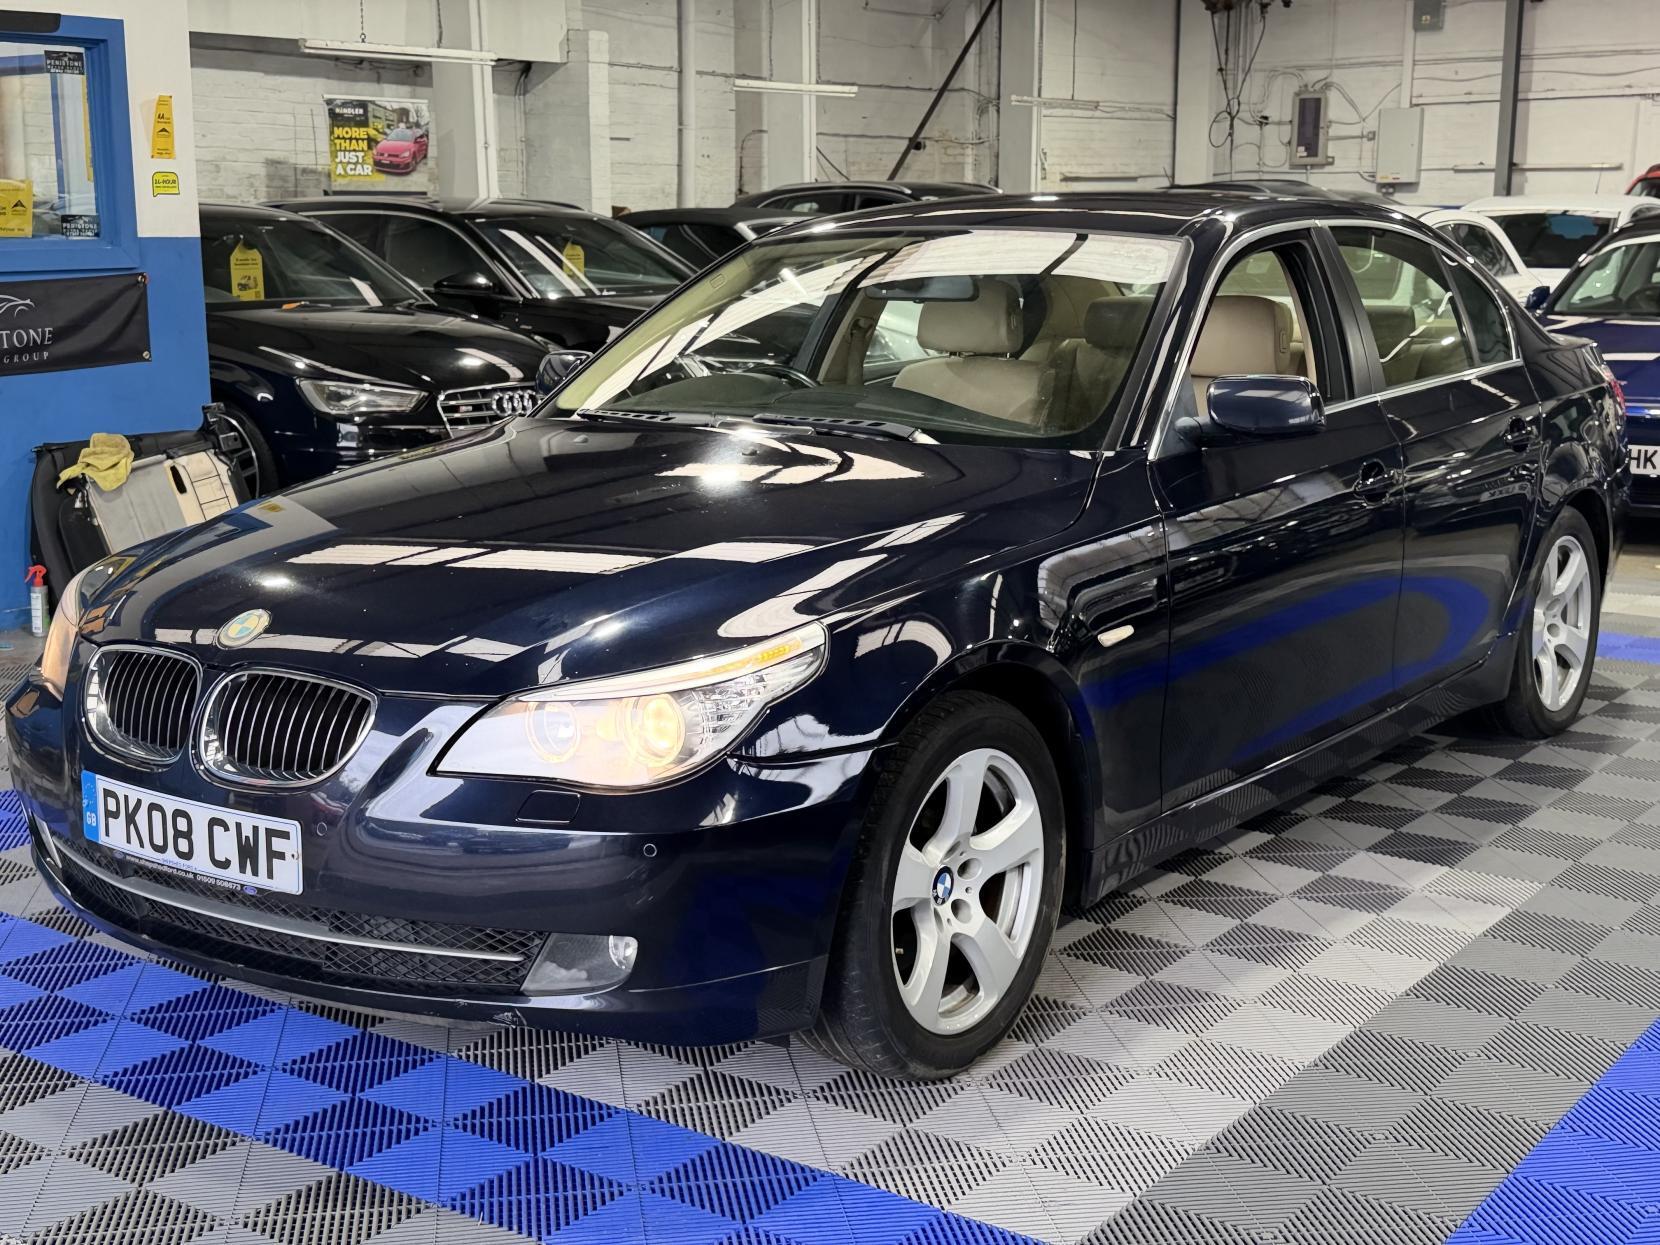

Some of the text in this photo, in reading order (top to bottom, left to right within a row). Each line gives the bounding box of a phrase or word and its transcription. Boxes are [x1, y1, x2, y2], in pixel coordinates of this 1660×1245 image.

[333, 127, 368, 139] MORE
[334, 140, 368, 151] THAN
[335, 151, 365, 163] JUST
[336, 164, 373, 176] A CAR
[0, 327, 54, 349] TONE
[3, 351, 49, 364] GROUP
[86, 811, 97, 827] GB
[102, 787, 291, 880] PK08 CWF
